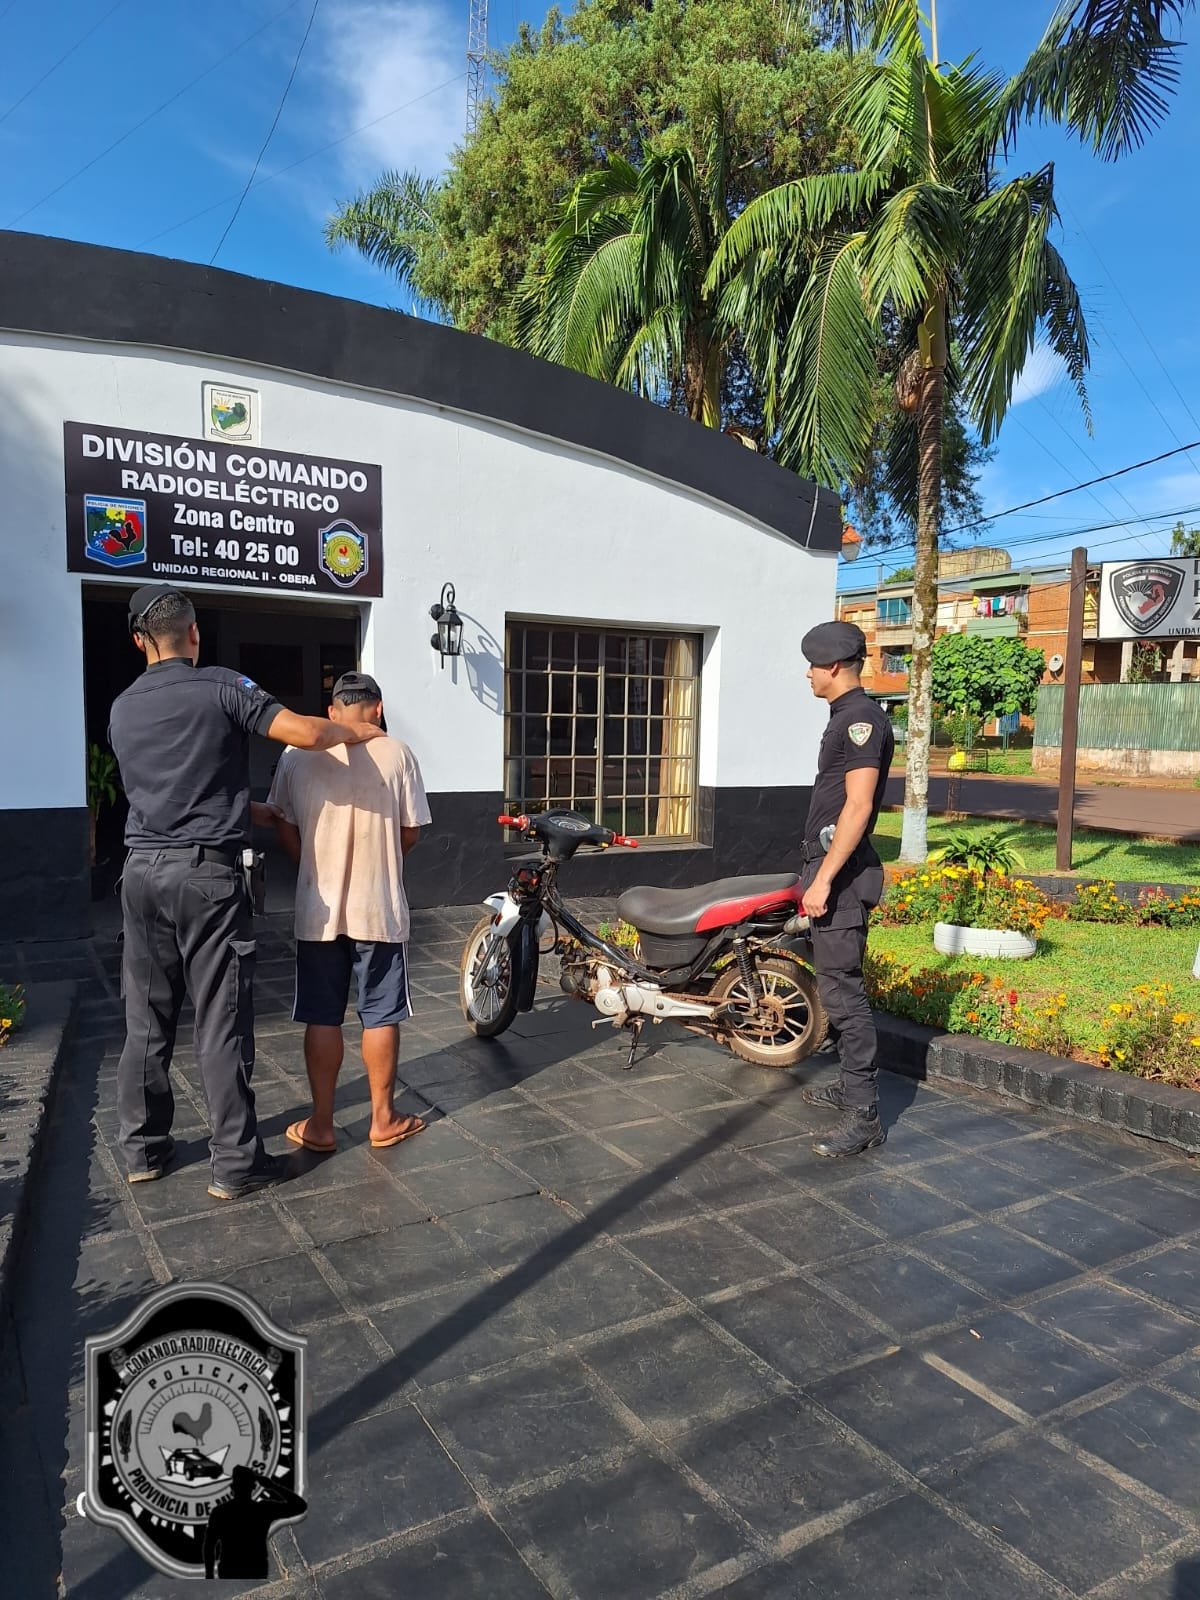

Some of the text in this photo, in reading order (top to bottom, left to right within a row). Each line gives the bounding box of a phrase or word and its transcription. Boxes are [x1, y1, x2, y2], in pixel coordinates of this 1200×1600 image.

[82, 434, 368, 493] DIVISIÓN COMANDO
[122, 470, 339, 513] RADIOELÉCTRICO
[173, 503, 295, 536] Zona Centro
[171, 534, 208, 557] Tel:
[214, 539, 240, 561] 40
[245, 541, 270, 563] 25
[275, 545, 299, 566] 00
[152, 562, 198, 575] UNIDAD
[201, 567, 259, 581] REGIONAL
[262, 572, 269, 581] II
[279, 573, 317, 585] OBERÁ
